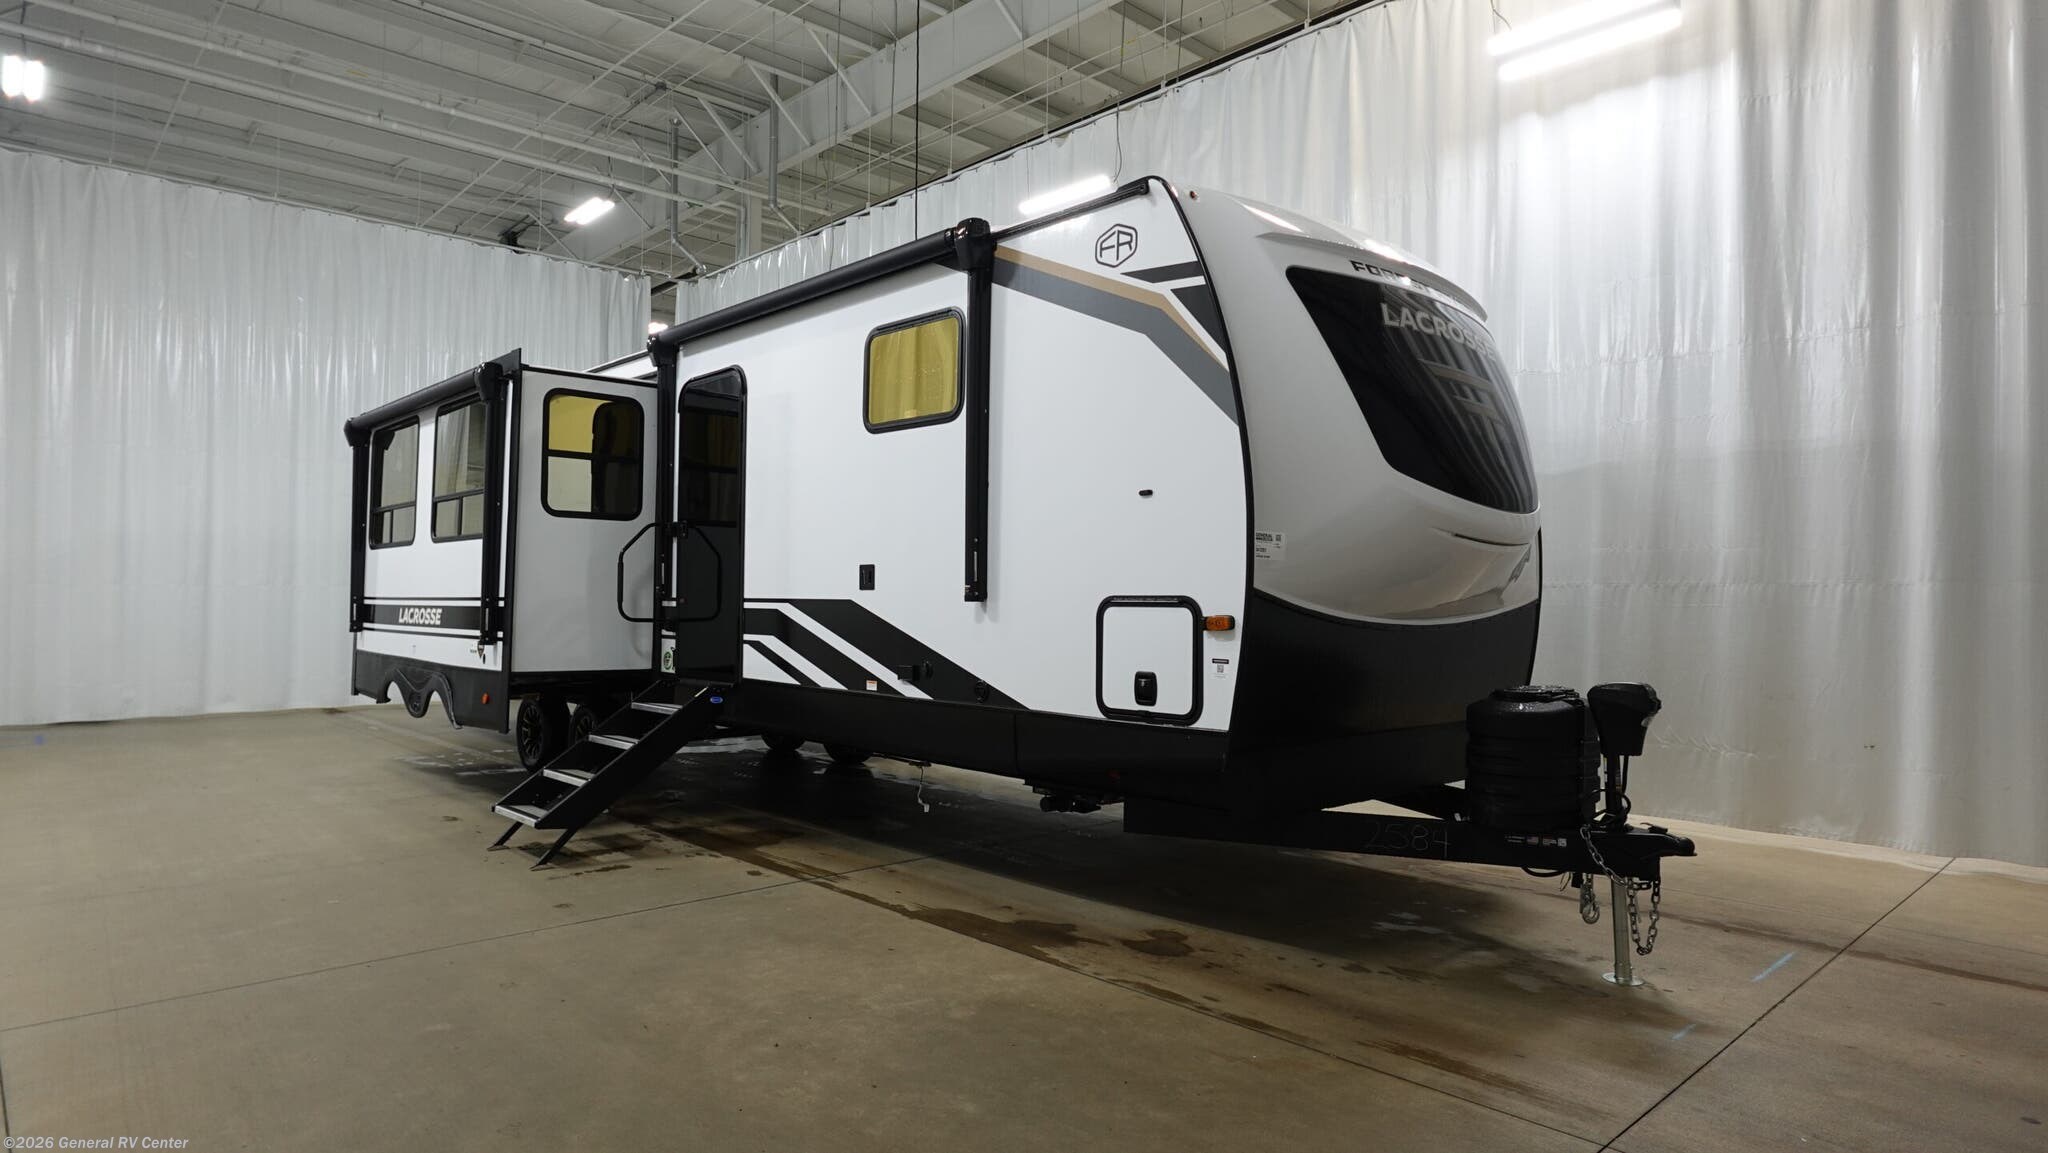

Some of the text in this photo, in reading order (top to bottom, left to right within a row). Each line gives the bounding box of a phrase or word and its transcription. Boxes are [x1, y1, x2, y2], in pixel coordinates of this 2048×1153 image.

[1380, 302, 1497, 361] LACROSSE
[398, 607, 442, 625] LACROSSE
[1364, 822, 1452, 858] 2584
